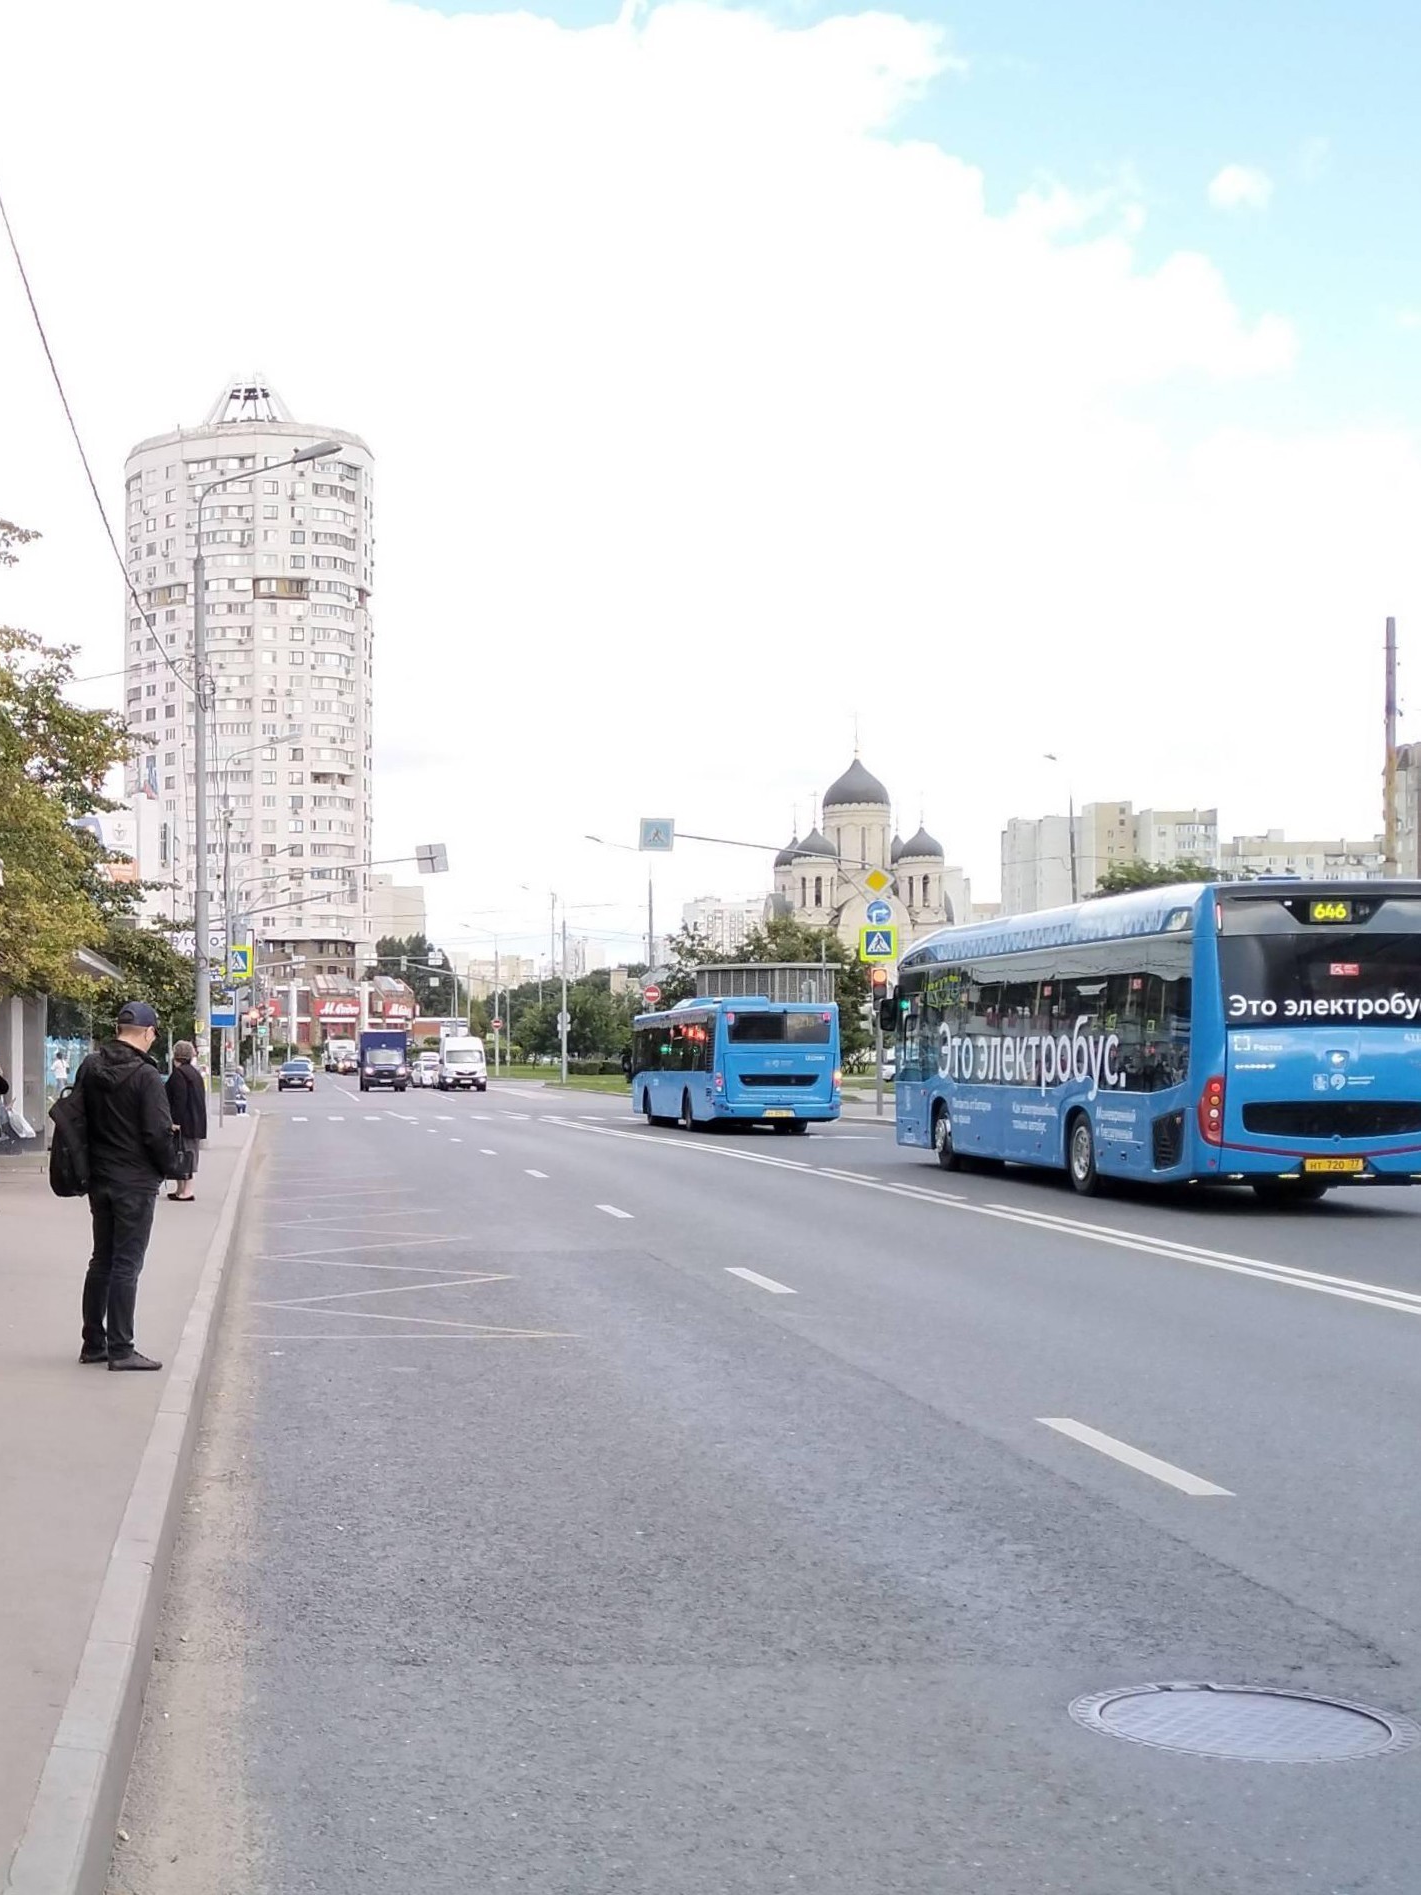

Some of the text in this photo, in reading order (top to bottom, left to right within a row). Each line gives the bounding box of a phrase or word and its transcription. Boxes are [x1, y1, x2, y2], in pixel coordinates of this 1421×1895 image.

[1314, 903, 1347, 920] 646
[1229, 994, 1278, 1017] Это
[938, 1014, 1127, 1101] Это электробус.
[1327, 1161, 1345, 1170] 720
